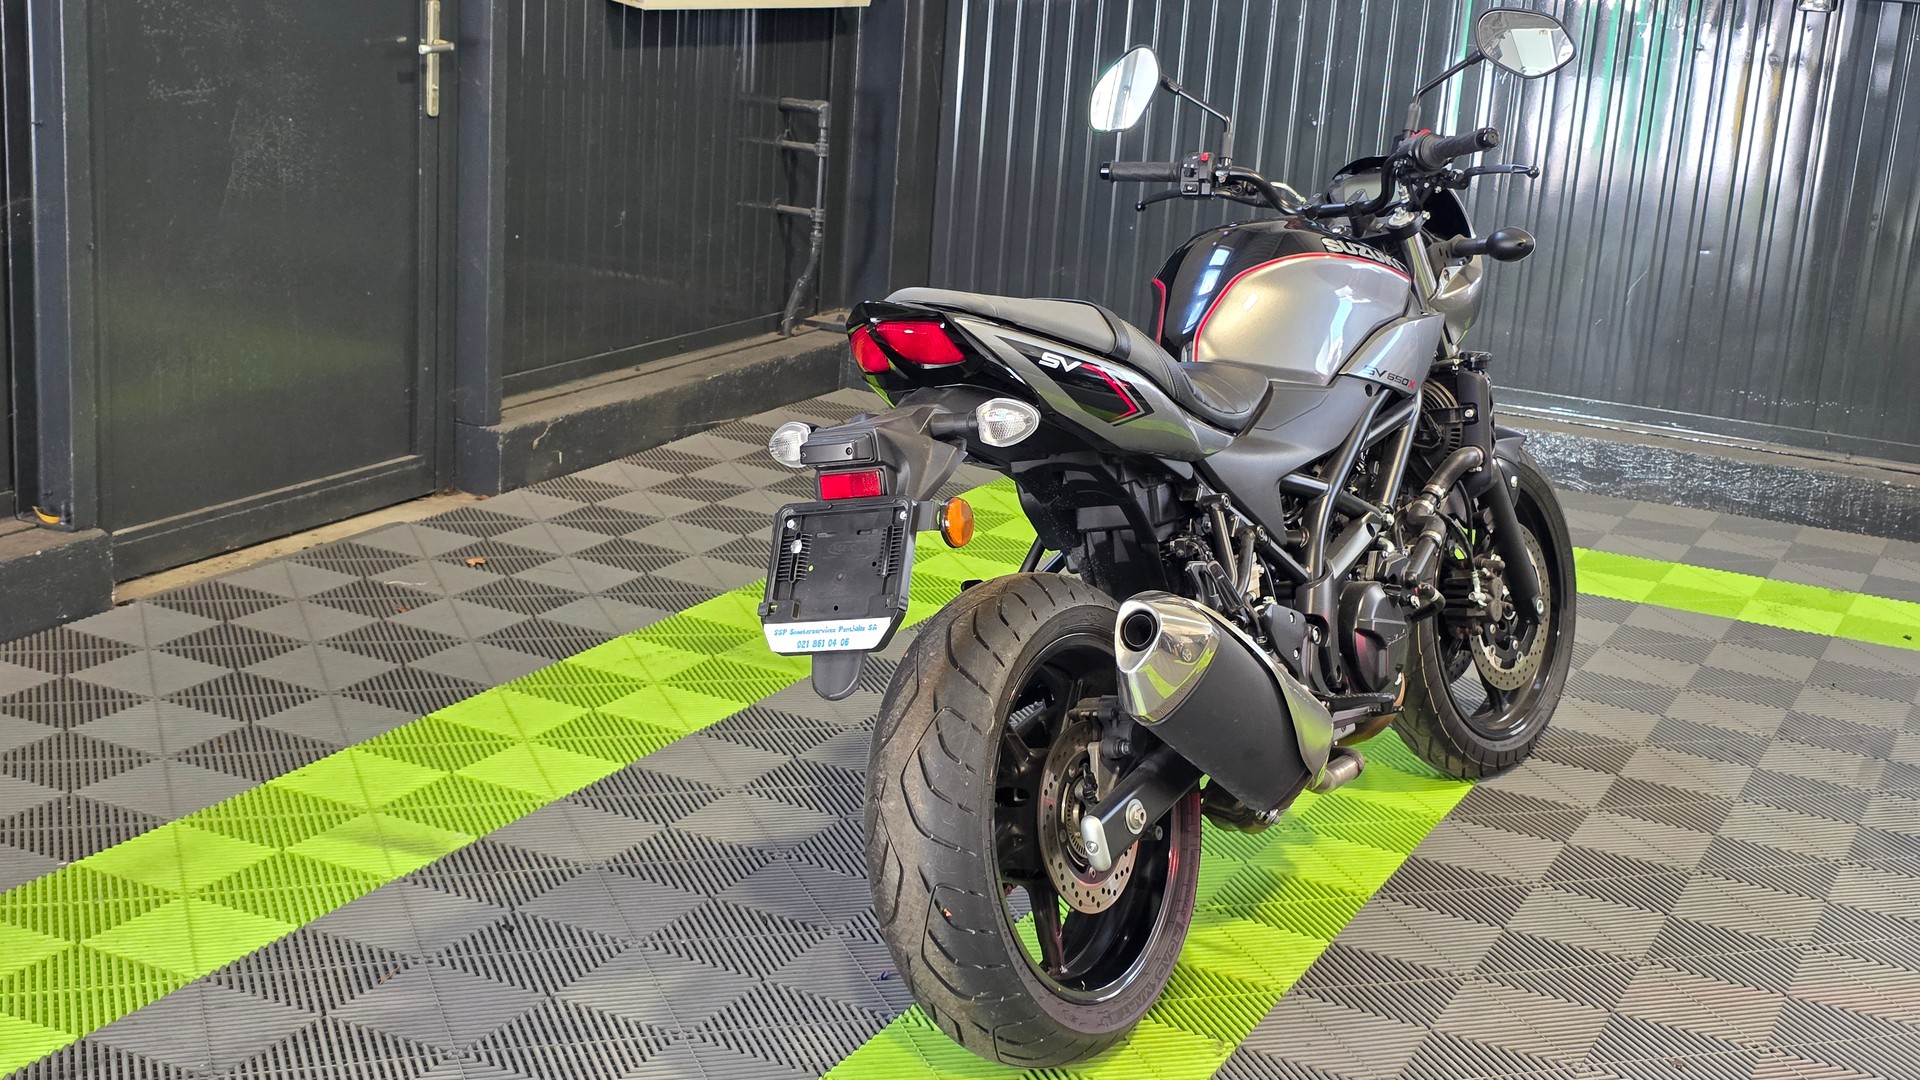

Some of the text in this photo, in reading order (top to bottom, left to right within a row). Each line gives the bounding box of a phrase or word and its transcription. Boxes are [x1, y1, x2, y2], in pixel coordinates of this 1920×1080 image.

[1038, 352, 1082, 373] SV
[797, 638, 850, 649] 021 861 04 06
